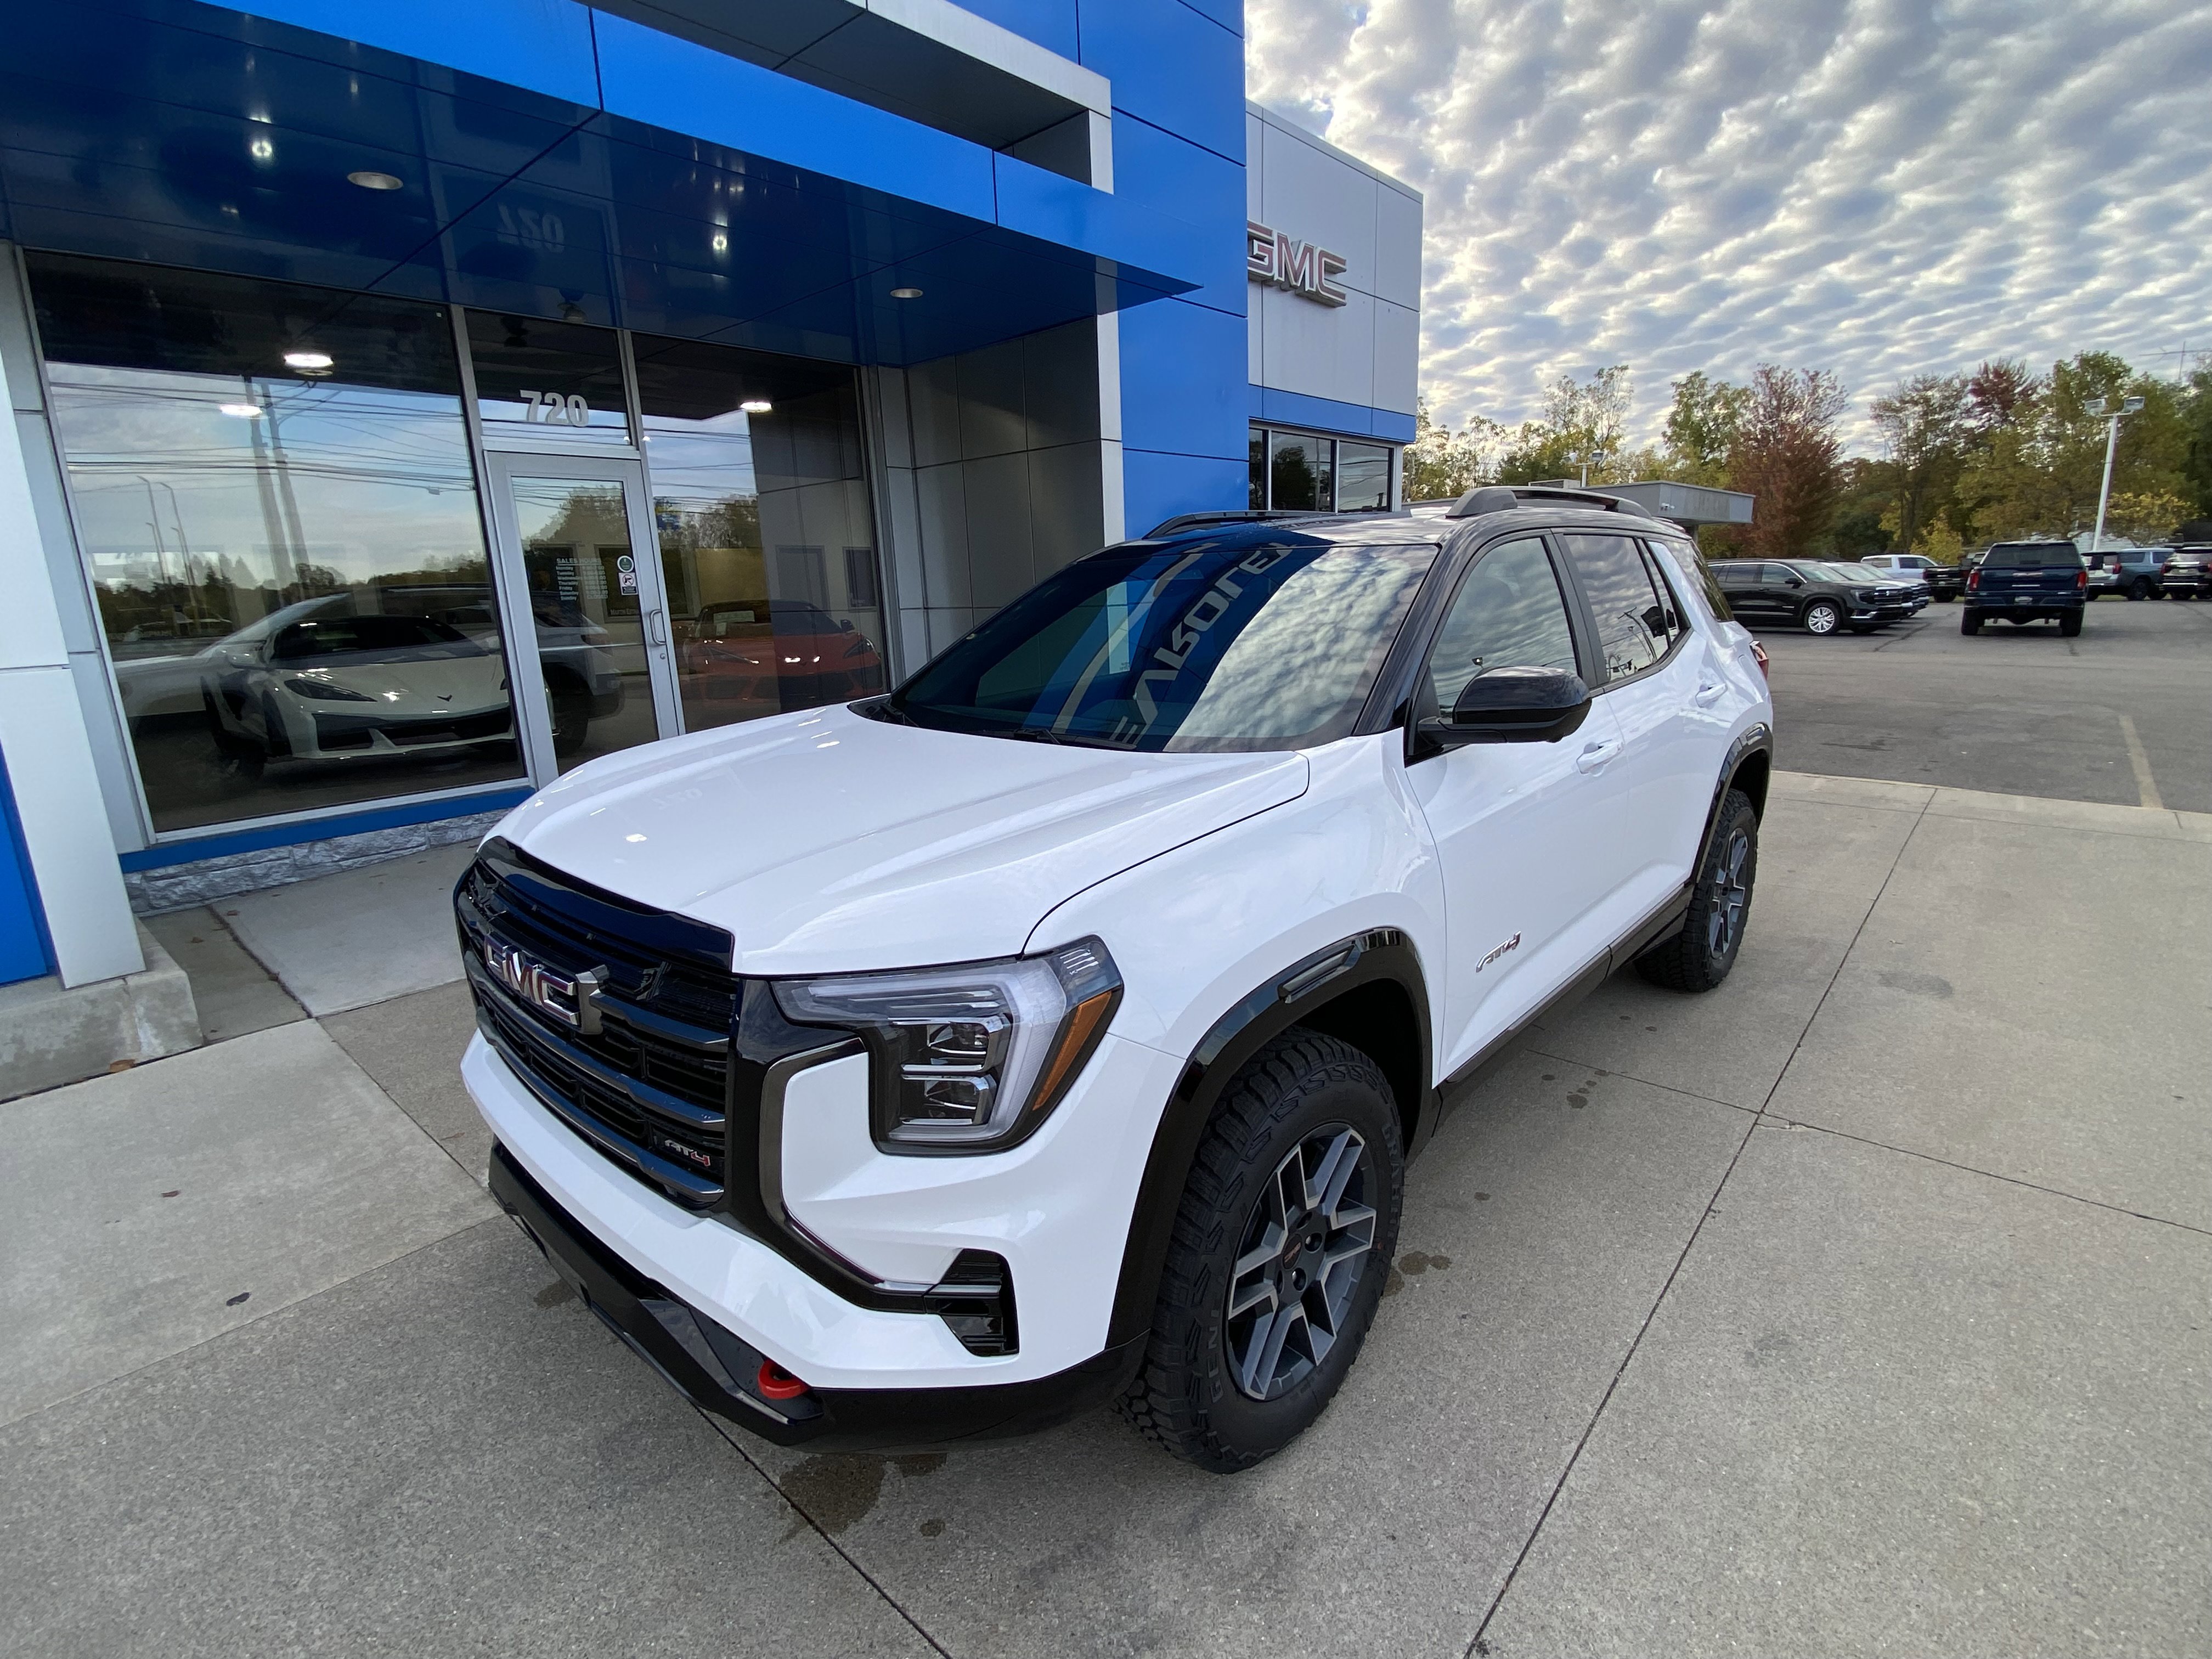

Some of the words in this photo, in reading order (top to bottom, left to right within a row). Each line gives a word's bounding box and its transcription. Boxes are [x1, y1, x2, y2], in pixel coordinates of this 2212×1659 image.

[1248, 221, 1347, 308] GMC
[520, 389, 589, 427] 720
[1475, 930, 1522, 973] AT4
[483, 934, 580, 1026] GMC
[664, 1138, 712, 1167] AT4
